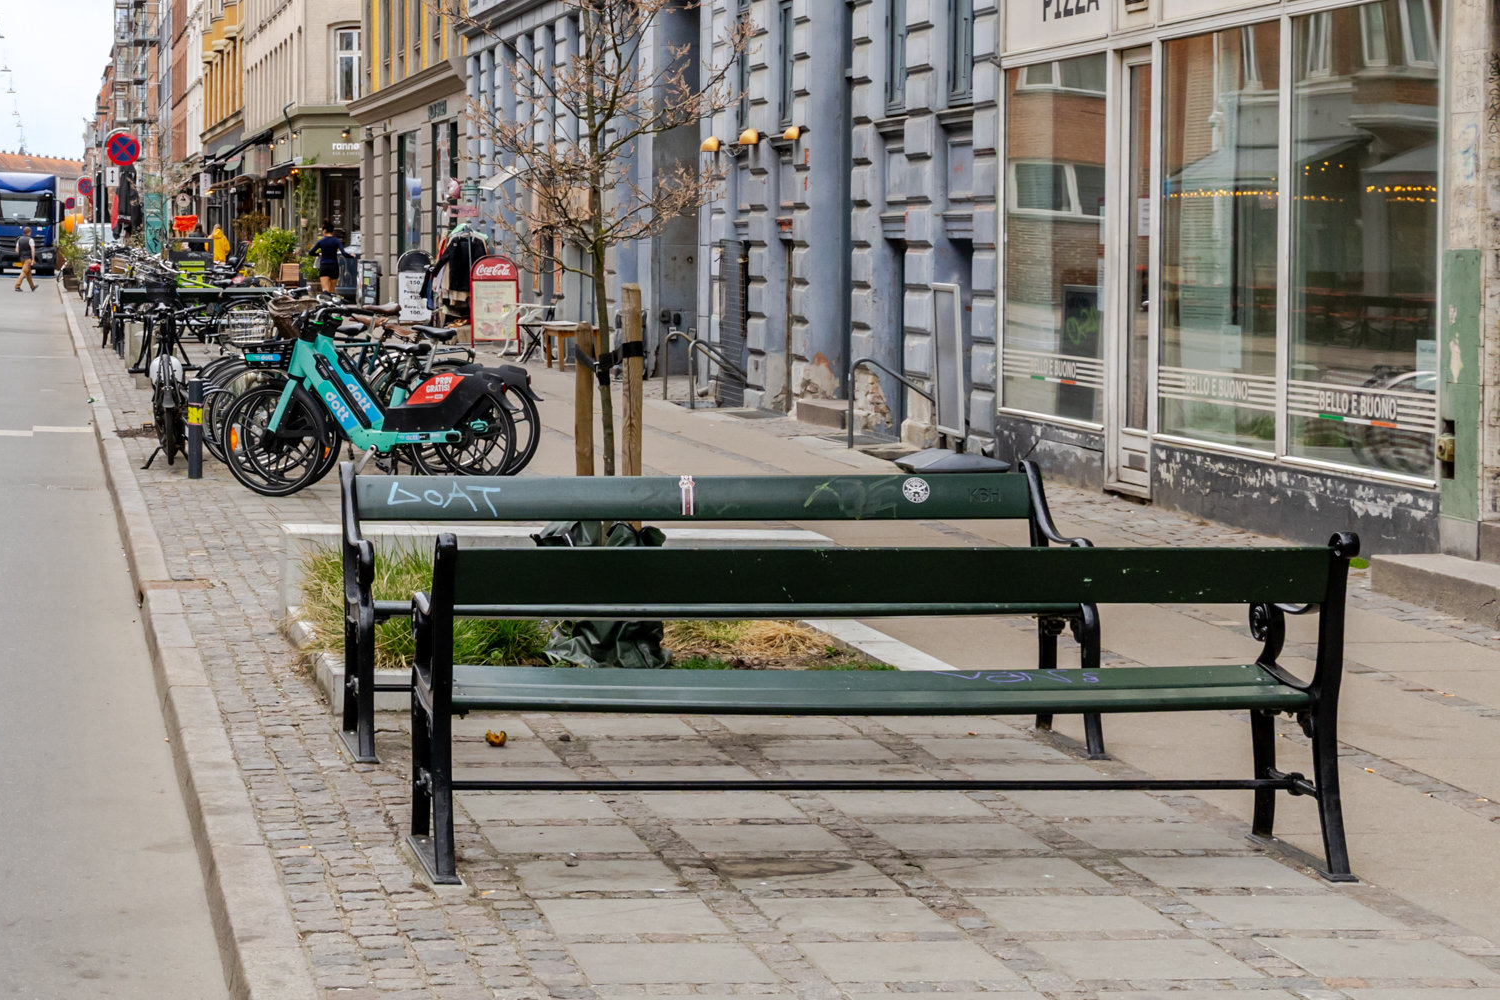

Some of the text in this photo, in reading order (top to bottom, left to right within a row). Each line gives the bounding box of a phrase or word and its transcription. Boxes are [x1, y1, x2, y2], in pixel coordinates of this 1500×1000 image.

[1030, 356, 1077, 378] BELLO E BUONO
[347, 383, 371, 413] dott
[426, 384, 450, 393] GRATIS!
[1185, 376, 1249, 400] BELLO E BUONO
[325, 392, 349, 422] dott
[1319, 390, 1397, 420] BELLO E BUONO
